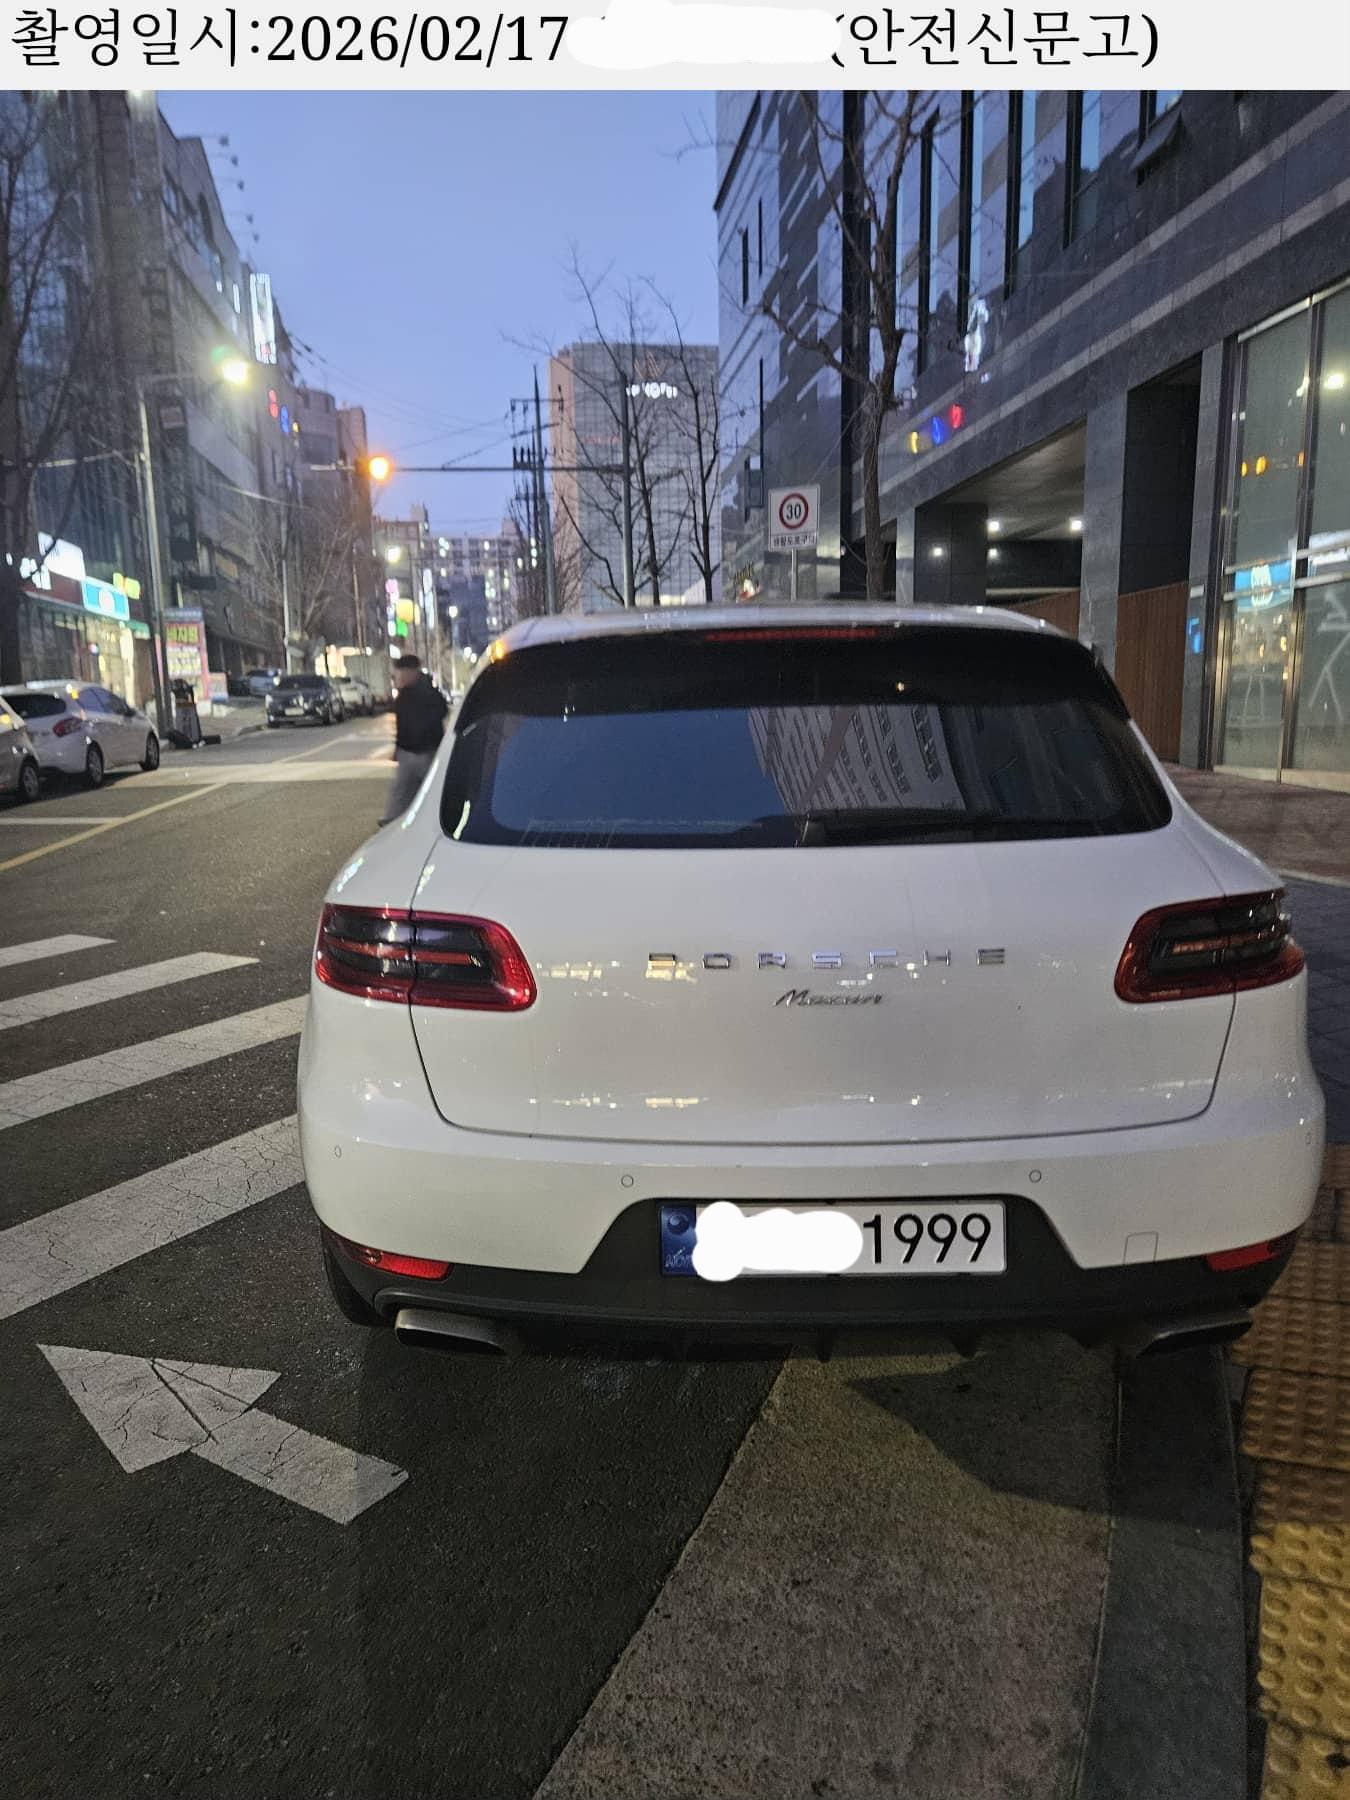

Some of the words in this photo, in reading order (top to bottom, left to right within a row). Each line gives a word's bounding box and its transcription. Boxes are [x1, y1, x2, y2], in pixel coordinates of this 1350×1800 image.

[786, 503, 801, 520] 30
[647, 947, 1007, 970] PORSCHE
[773, 988, 882, 1009] Macan
[862, 1212, 992, 1265] 1999
